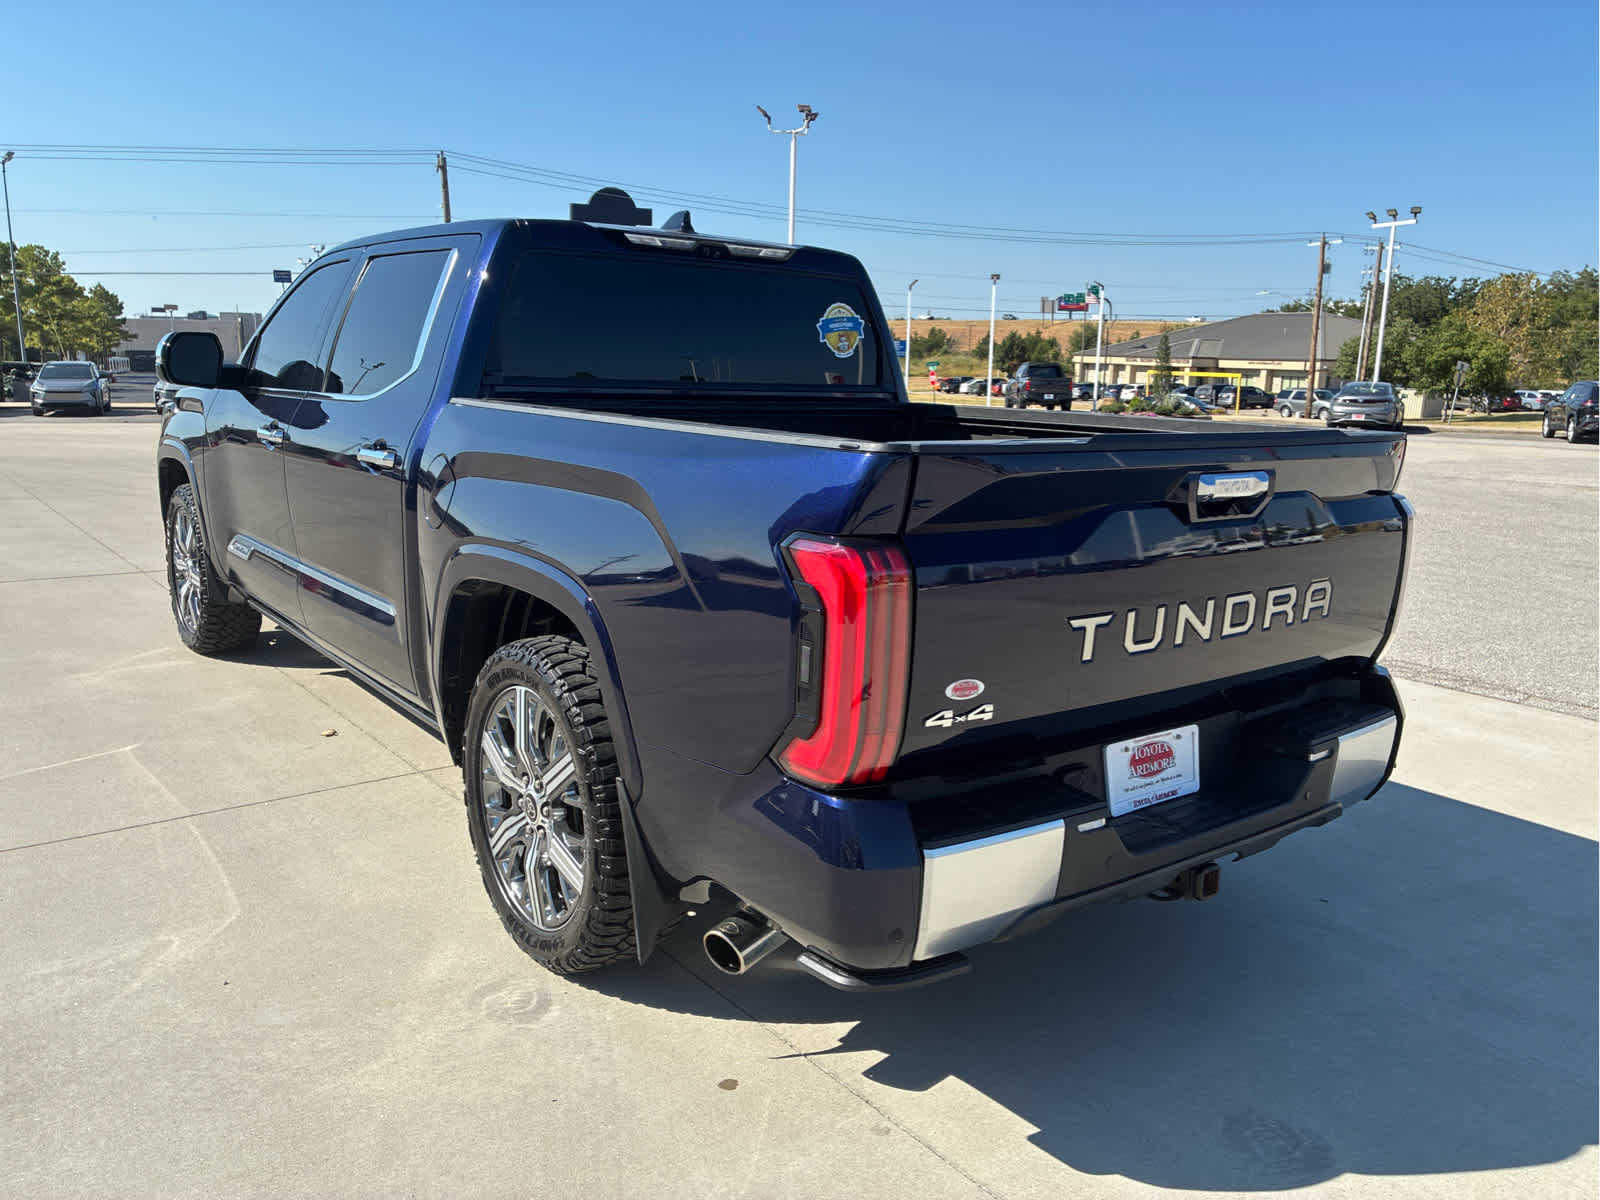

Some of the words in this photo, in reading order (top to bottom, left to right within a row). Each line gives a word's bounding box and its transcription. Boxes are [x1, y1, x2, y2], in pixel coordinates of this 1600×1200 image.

[1067, 577, 1333, 662] TUNDRA
[924, 704, 994, 728] 4x4
[1134, 743, 1170, 760] TOYOTA
[1128, 757, 1177, 779] ARDMORE
